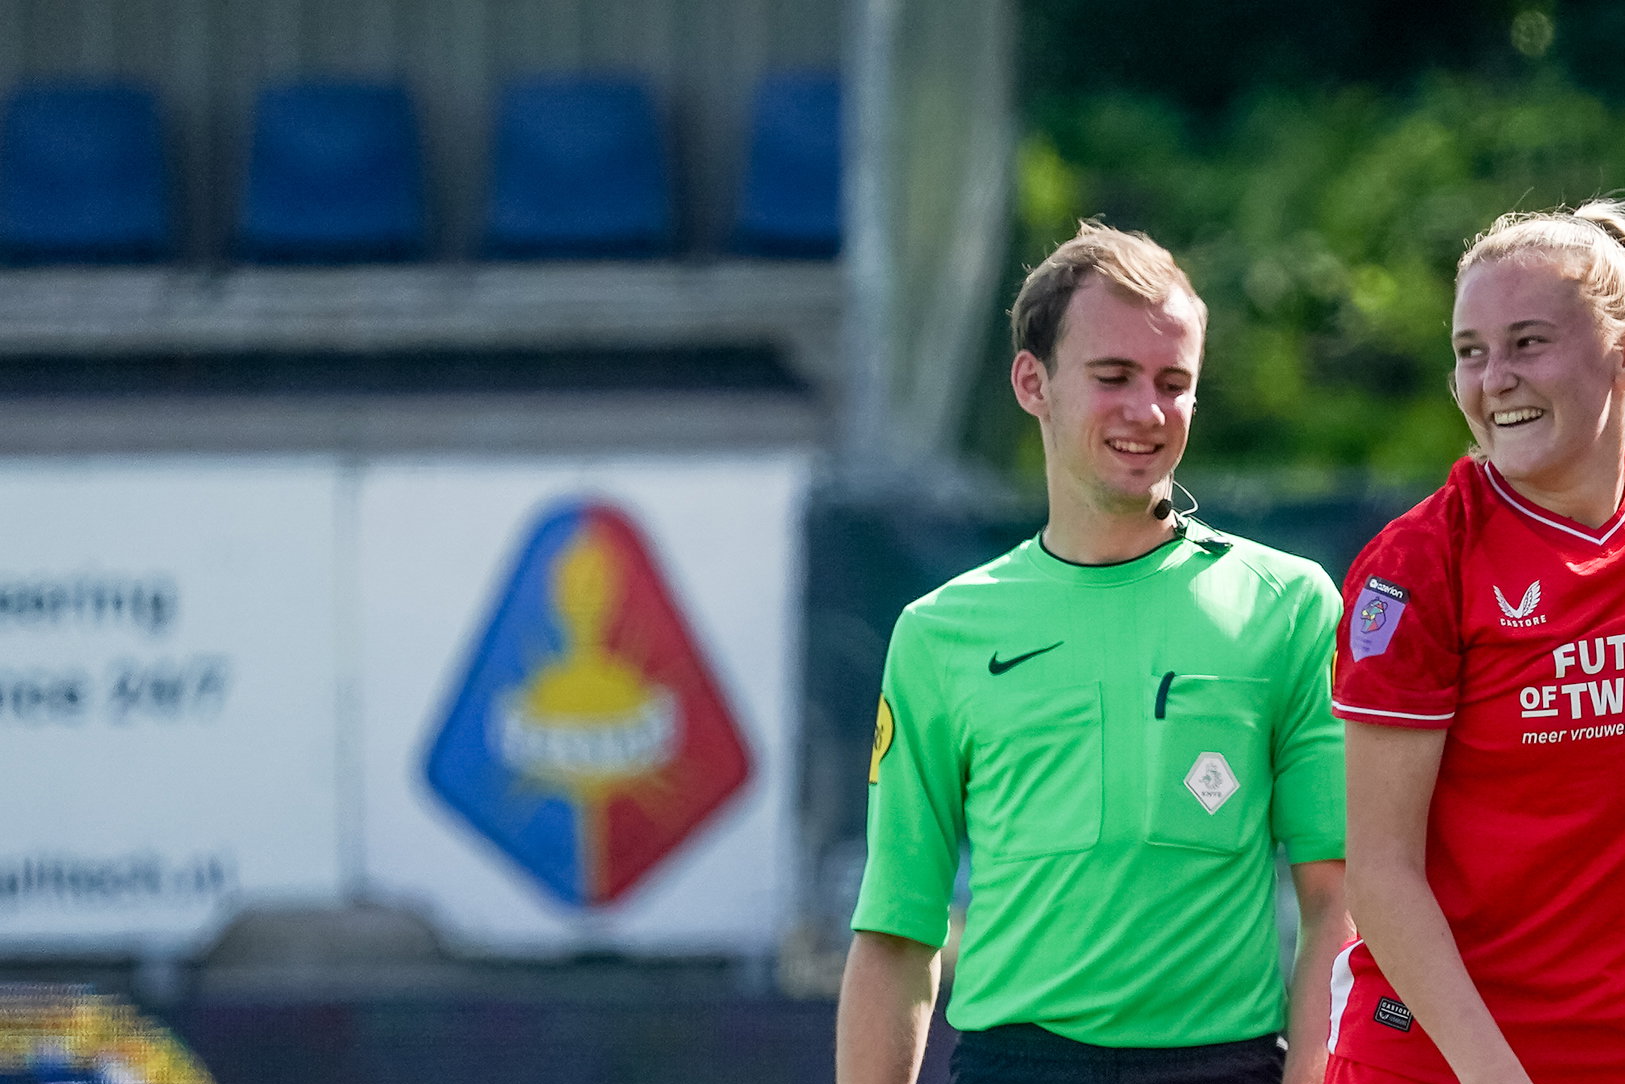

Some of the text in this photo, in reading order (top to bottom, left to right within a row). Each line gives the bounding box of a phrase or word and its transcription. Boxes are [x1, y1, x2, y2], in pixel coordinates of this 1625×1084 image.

[1500, 614, 1547, 628] CASTORE
[1519, 685, 1557, 710] OF
[1522, 729, 1567, 744] meer
